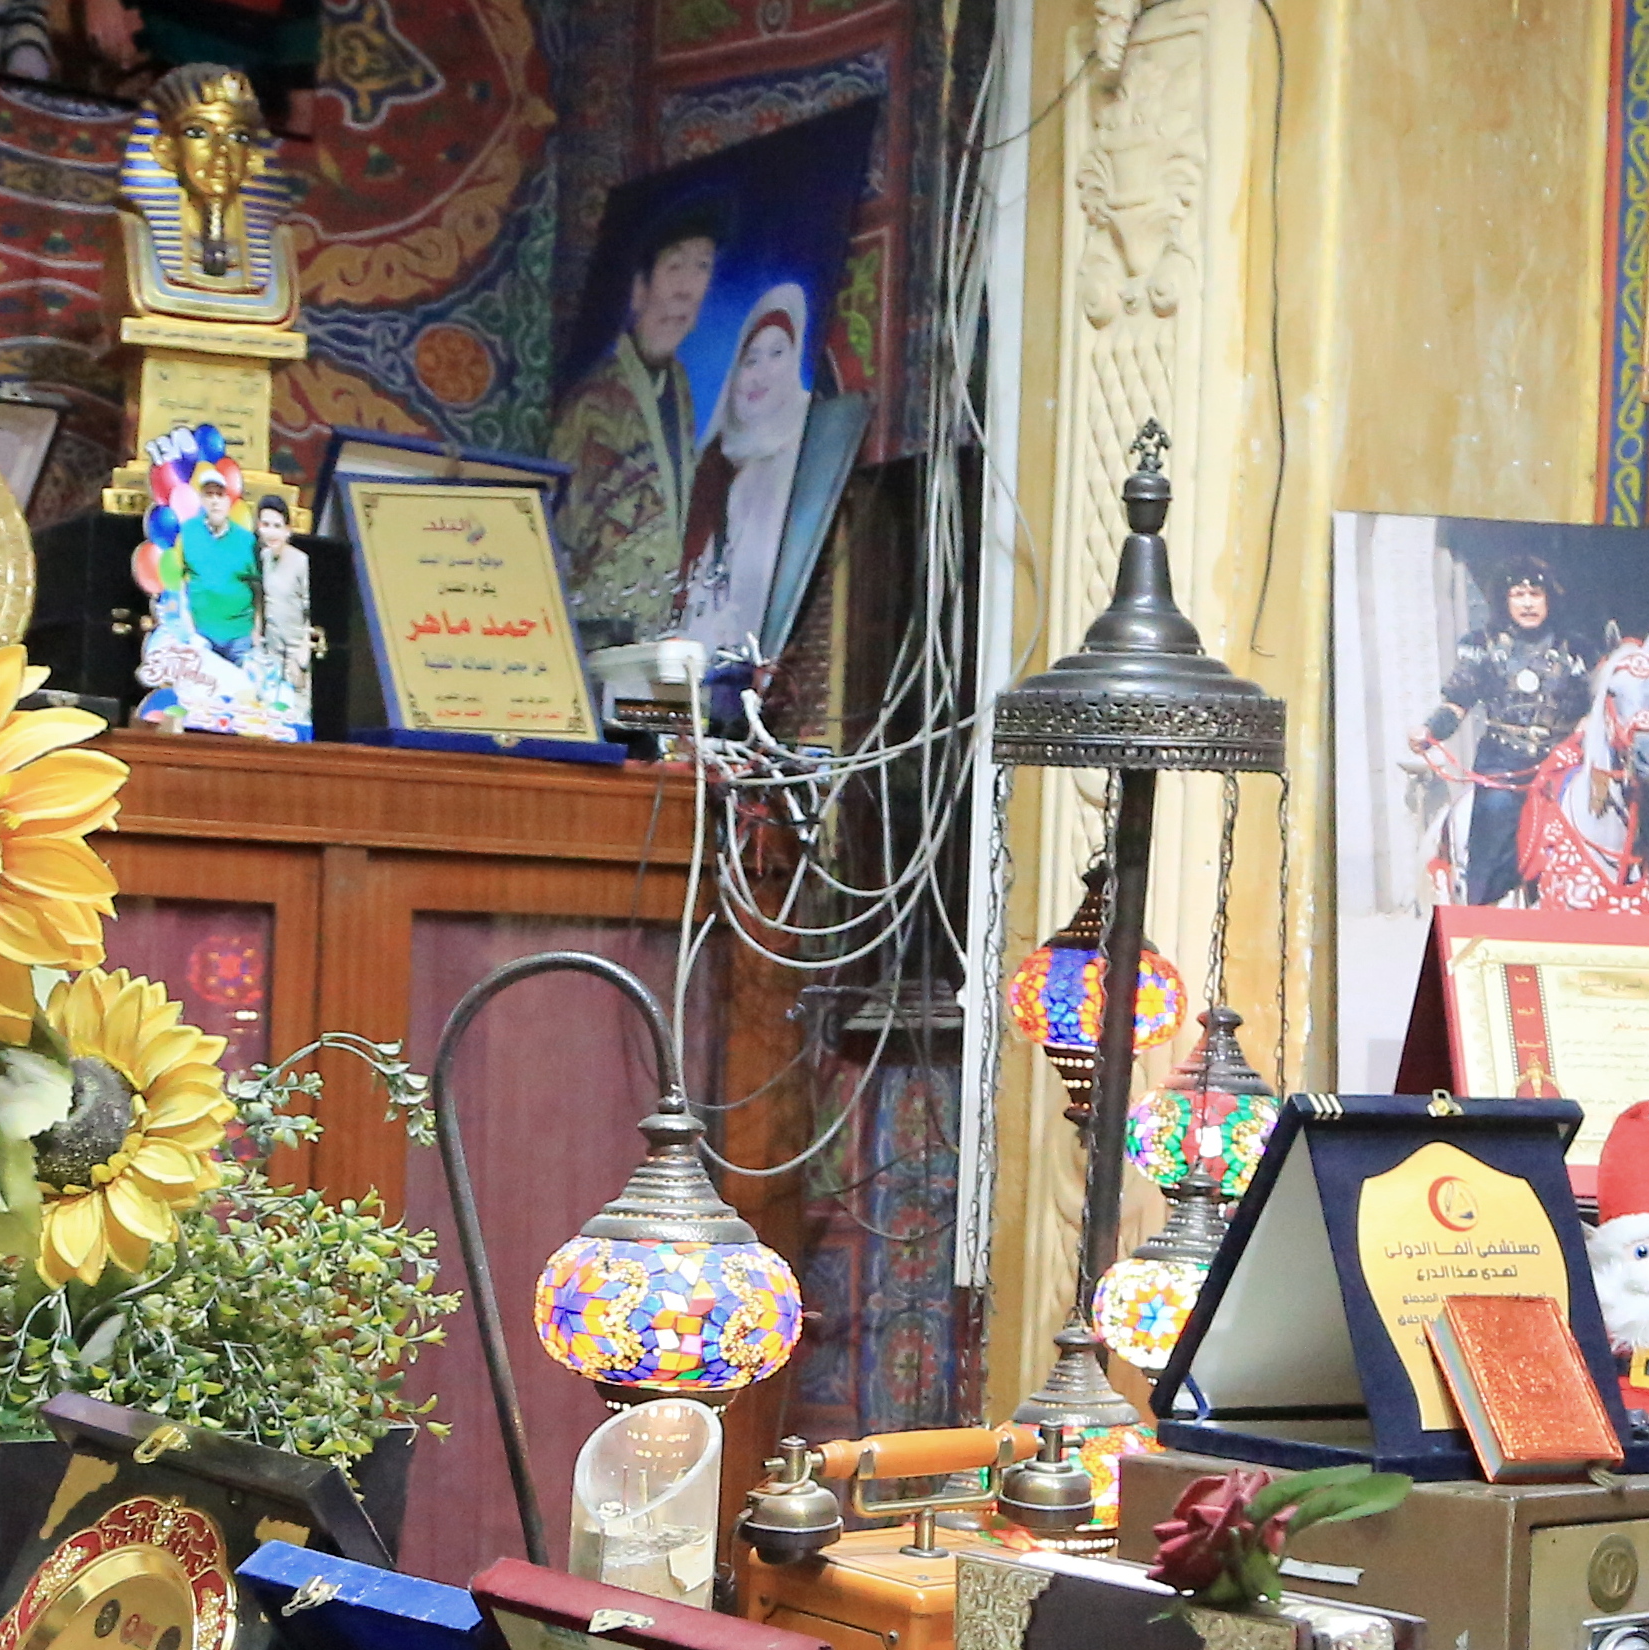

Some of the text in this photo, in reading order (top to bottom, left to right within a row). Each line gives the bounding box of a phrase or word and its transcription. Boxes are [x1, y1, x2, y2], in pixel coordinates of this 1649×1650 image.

[405, 607, 553, 643] أحمد ماهر
[1475, 1238, 1541, 1259] مستشفى
[1415, 1264, 1450, 1282] الدرع
[1449, 1264, 1479, 1279] هذا
